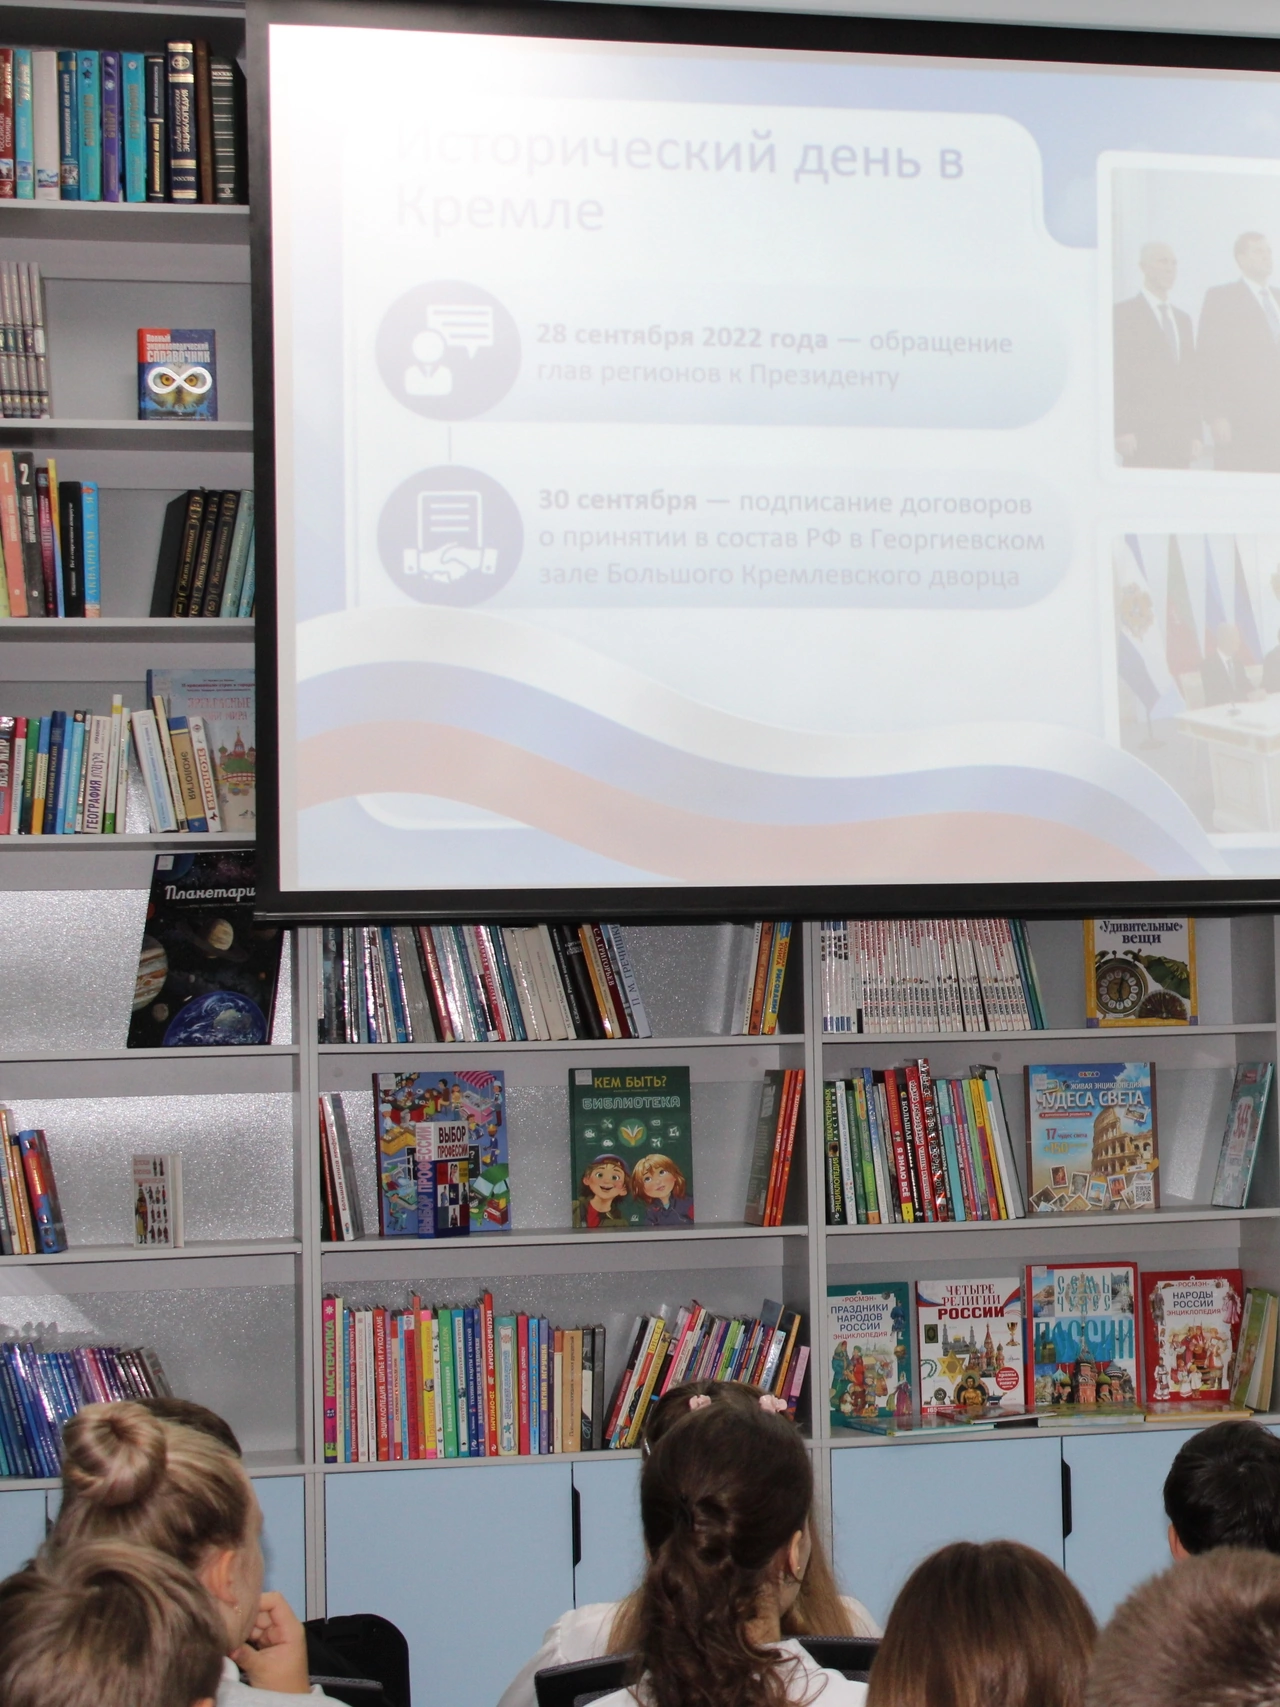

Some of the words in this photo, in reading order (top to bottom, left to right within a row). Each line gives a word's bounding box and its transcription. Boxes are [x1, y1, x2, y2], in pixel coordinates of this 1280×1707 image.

[180, 88, 191, 152] ЭНЦИКЛОПЕДИЯ
[402, 128, 777, 176] Исторический
[794, 144, 922, 183] день
[940, 148, 964, 179] в
[397, 183, 604, 237] Кремле
[536, 322, 566, 344] 28
[575, 323, 694, 347] сентября
[701, 327, 762, 348] 2022
[769, 330, 827, 351] года
[869, 330, 1011, 355] обращение
[536, 363, 591, 382] глав
[601, 363, 720, 387] регионов
[729, 368, 741, 383] к
[750, 363, 900, 392] Президенту
[20, 464, 29, 485] 2
[538, 488, 569, 510] 30
[579, 488, 697, 514] сентября
[740, 493, 891, 514] подписание
[900, 497, 1031, 518] договоров
[200, 530, 212, 564] животных
[539, 530, 554, 546] о
[562, 529, 686, 552] принятии
[695, 530, 708, 547] в
[716, 530, 798, 548] состав
[806, 527, 841, 549] РФ
[850, 531, 862, 548] в
[870, 528, 1044, 554] Георгиевском
[87, 531, 97, 596] АКВАРИУМ
[196, 564, 206, 588] Жизнь
[539, 566, 599, 584] зале
[606, 563, 733, 586] Большого
[741, 564, 920, 590] Кремлевского
[928, 568, 1019, 588] дворца
[181, 751, 196, 800] ЭКОЛОГИЯ
[198, 748, 216, 809] ЭКОЛОГИЯ
[87, 780, 101, 829] ГЕОГРАФИЯ
[1099, 920, 1183, 933] «Удивительные»
[1122, 933, 1162, 945] вещи
[597, 943, 614, 986] ГРИГОРЬЕВ
[776, 943, 784, 964] КНИГА
[771, 968, 783, 1014] РИСОВАНИЯ
[594, 1076, 621, 1088] КЕМ
[625, 1075, 667, 1088] БЫТЬ?
[1094, 1082, 1142, 1090] ЭНЦИКЛОПЕДИЯ
[582, 1095, 681, 1110] БИБЛИОТЕКА
[1036, 1091, 1095, 1109] ЧУДЕСА
[1099, 1090, 1145, 1107] СВЕТА
[825, 1088, 833, 1141] ЛЕКАРСТВЕННЫХ
[901, 1100, 912, 1141] БОЛЬШАЯ
[438, 1125, 467, 1144] ВЫБОР
[1046, 1128, 1057, 1140] 17
[437, 1143, 469, 1158] ПРОФЕССИИ
[1043, 1142, 1068, 1154] +150
[334, 1160, 342, 1180] книга
[417, 1126, 433, 1193] ПРОФЕССИИ
[898, 1155, 907, 1179] ЗНАЮ
[833, 1157, 841, 1212] ЭНЦИКЛОПЕДИЯ
[418, 1194, 434, 1234] ВЫБОР
[945, 1284, 995, 1296] ЧЕТЫРЕ
[1057, 1275, 1110, 1295] СЕМЬ
[1172, 1291, 1214, 1300] НАРОДЫ
[830, 1304, 888, 1314] ПРАЗДНИКИ
[942, 1294, 1000, 1306] РЕЛИГИИ
[1057, 1294, 1110, 1314] ЧУДЕС
[1173, 1299, 1214, 1308] РОССИИ
[837, 1313, 883, 1323] НАРОДОВ
[938, 1306, 1005, 1320] РОССИИ
[1166, 1308, 1222, 1316] ЭНЦИКЛОПЕДИЯ
[833, 1331, 888, 1340] ЭНЦИКЛОПЕДИЯ
[839, 1322, 881, 1332] РОССИИ
[326, 1320, 335, 1397] МАСТЕРИЛКА
[379, 1383, 387, 1439] ЭНЦИКЛОПЕДИЯ.
[427, 1395, 436, 1443] Праздник
